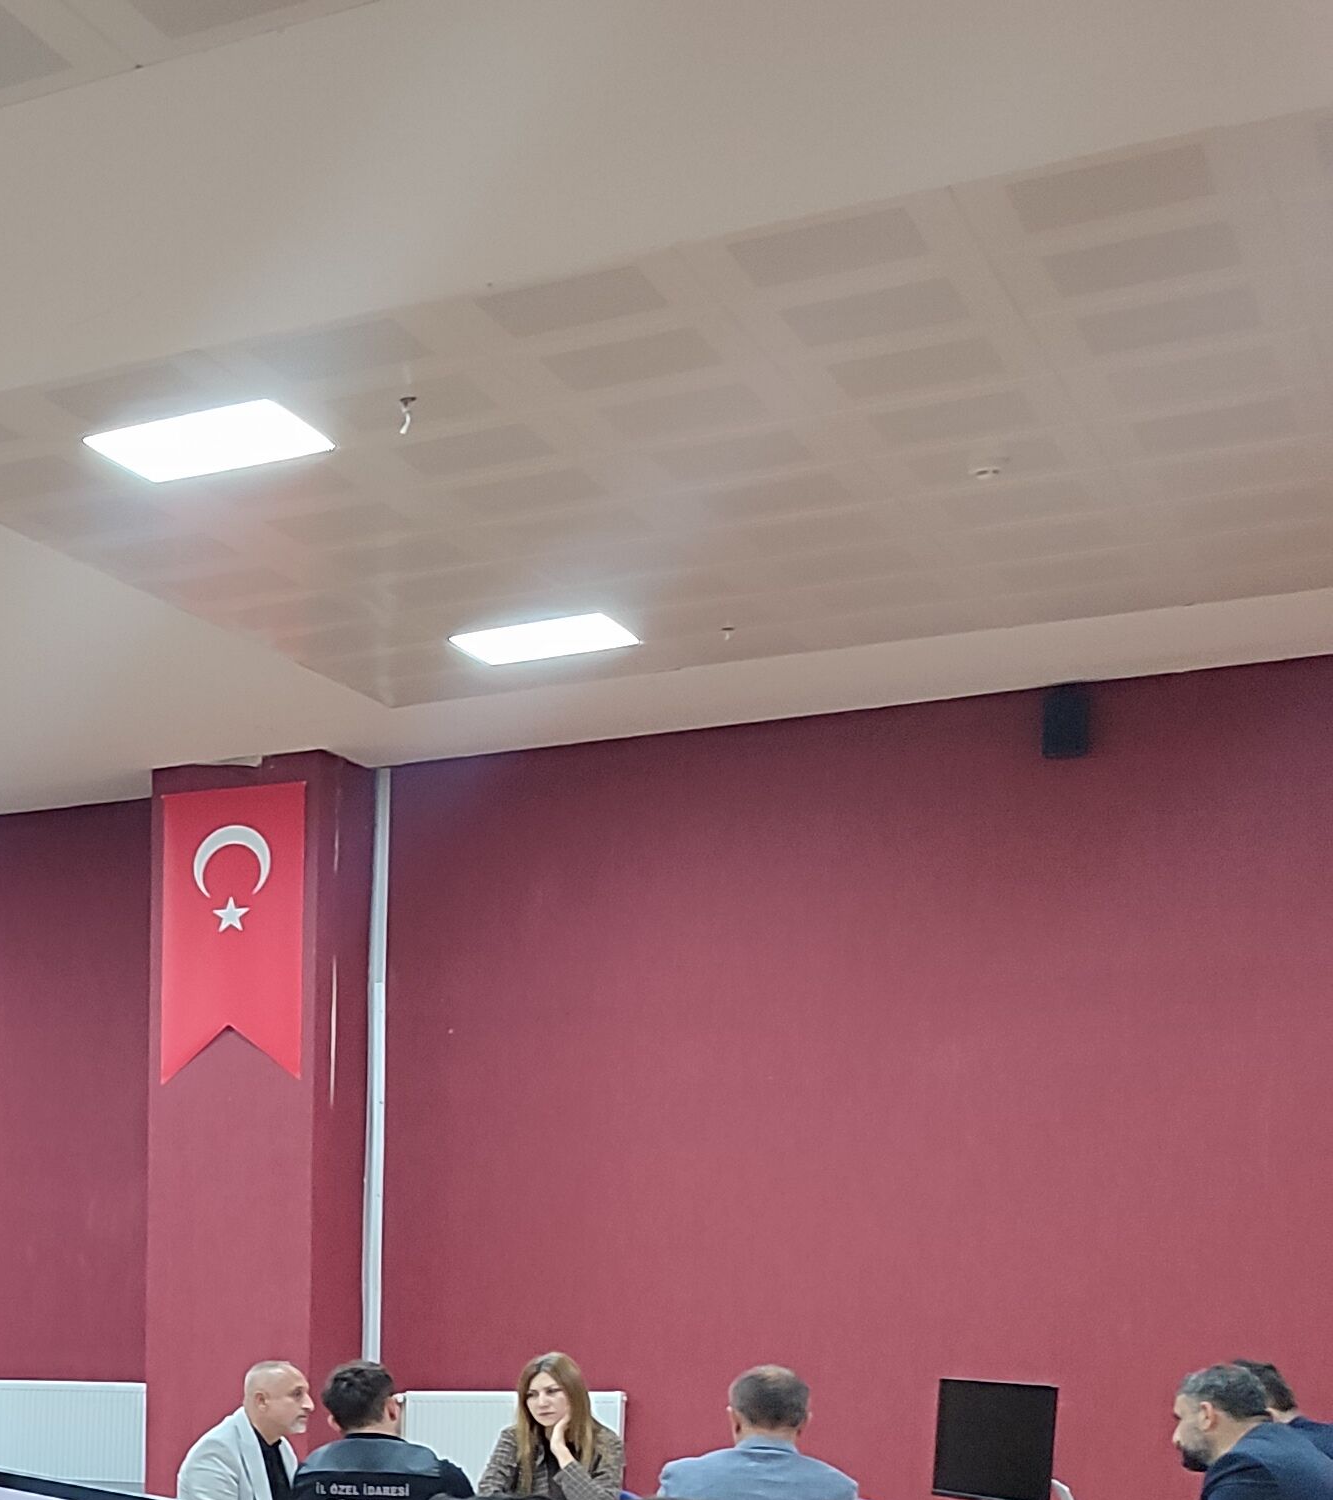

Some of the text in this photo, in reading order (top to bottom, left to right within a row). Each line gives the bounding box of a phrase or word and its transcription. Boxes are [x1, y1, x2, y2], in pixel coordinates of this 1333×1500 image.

[315, 1481, 410, 1496] İL ÖZEL İDARESİ
